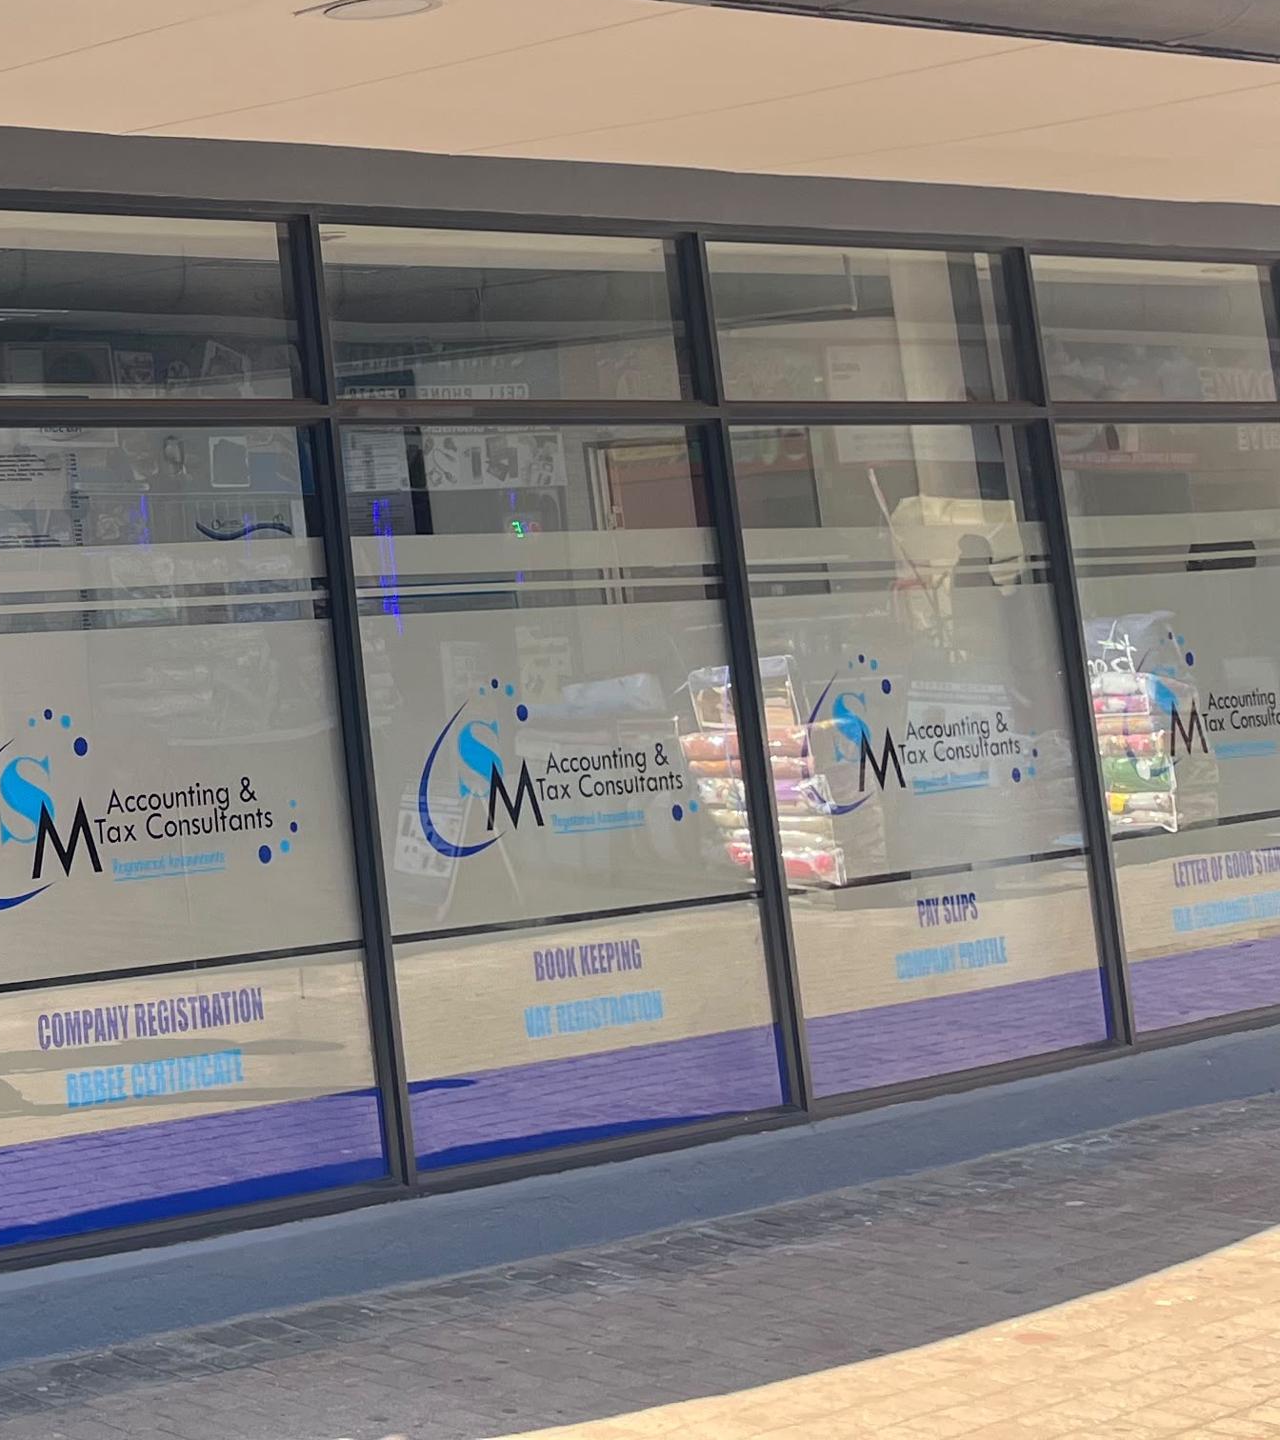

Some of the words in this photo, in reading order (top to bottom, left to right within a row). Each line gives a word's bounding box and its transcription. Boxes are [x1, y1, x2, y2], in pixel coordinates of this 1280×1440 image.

[1208, 688, 1276, 710] Accounting
[906, 715, 990, 740] Accounting
[995, 711, 1009, 733] &
[1202, 713, 1225, 733] Tax
[546, 747, 647, 775] Accounting
[654, 742, 670, 766] &
[898, 743, 929, 766] Tax
[933, 737, 1021, 762] Consultants
[107, 782, 230, 815] Accounting
[239, 777, 258, 803] &
[536, 777, 572, 802] Tax
[578, 771, 684, 798] Consultants
[94, 818, 137, 845] Tax
[146, 808, 274, 839] Consultants
[1173, 858, 1210, 888] LETTER
[1211, 856, 1223, 882] OF
[1225, 851, 1254, 879] GOOD
[917, 897, 940, 928] PAY
[942, 892, 979, 925] SLIPS
[533, 946, 578, 982] BOOK
[578, 938, 643, 977] KEEPING
[38, 1005, 129, 1050] COMPANY
[134, 987, 265, 1038] REGISTRATION
